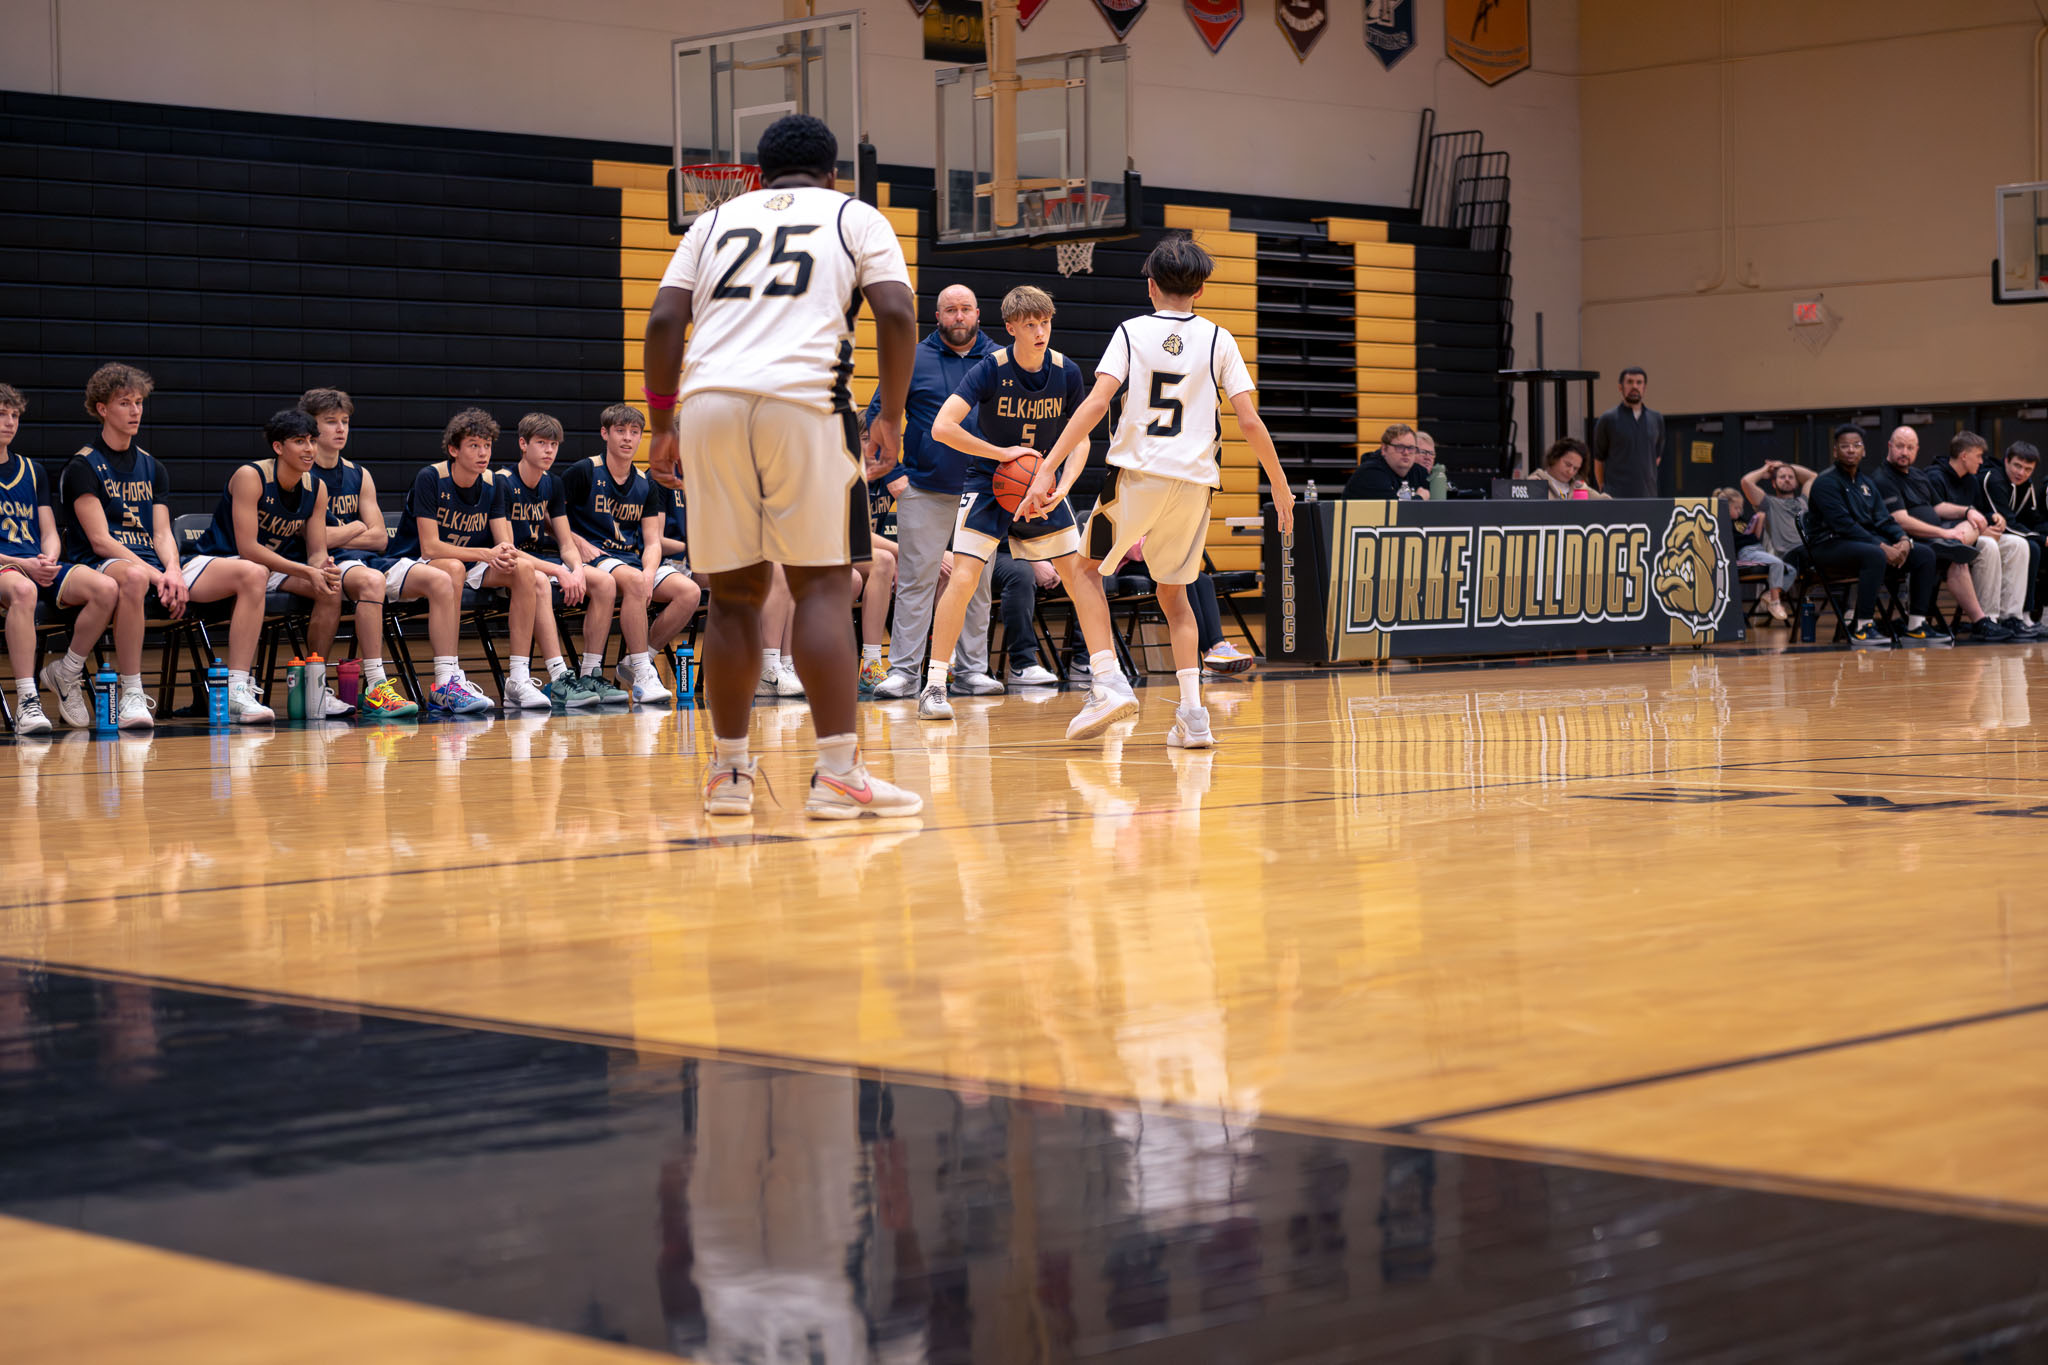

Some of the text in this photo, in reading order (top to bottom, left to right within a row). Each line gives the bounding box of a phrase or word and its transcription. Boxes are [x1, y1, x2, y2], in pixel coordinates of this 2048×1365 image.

[711, 224, 821, 300] 25
[997, 396, 1063, 420] ELKHORN
[1146, 370, 1189, 437] 5
[1020, 423, 1037, 448] 5
[1511, 485, 1529, 499] POSS.
[436, 506, 488, 532] ELKHORN
[594, 494, 643, 521] ELKHORN
[2, 517, 35, 545] 24
[1351, 530, 1646, 625] BURKE BULLDOGS
